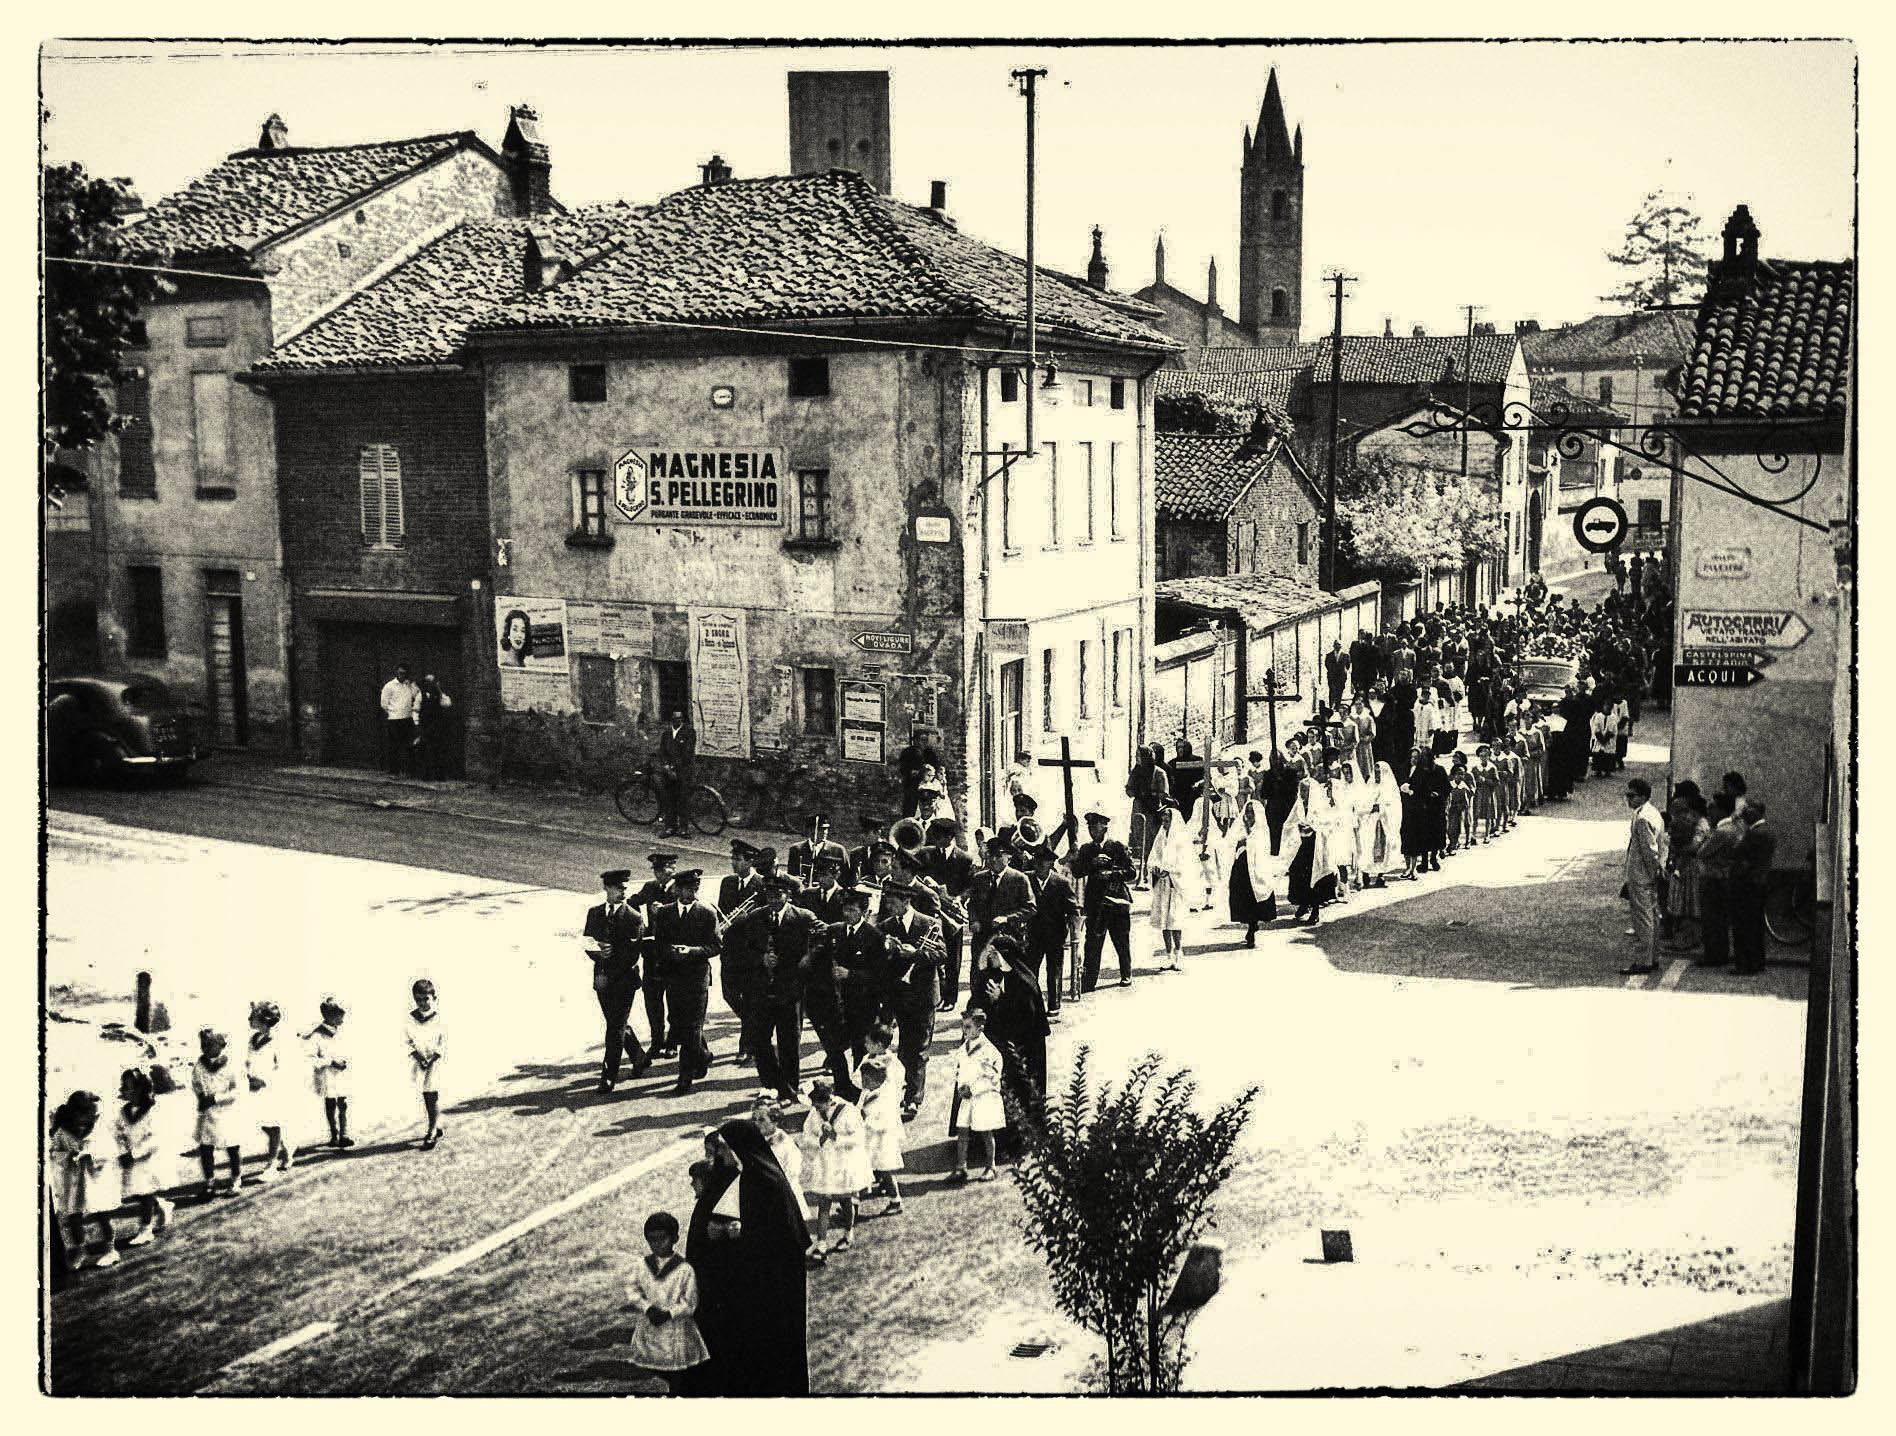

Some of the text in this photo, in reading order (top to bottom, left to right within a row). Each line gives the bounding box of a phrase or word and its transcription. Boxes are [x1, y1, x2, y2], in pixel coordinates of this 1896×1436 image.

[650, 452, 777, 479] MAGNESIA
[668, 481, 778, 507] PELLEGRINO
[1688, 613, 1791, 634] AUTOCARRI
[1700, 627, 1777, 637] VIETATO TRANSITO
[873, 640, 903, 649] OVADA
[1687, 669, 1735, 684] ACQUI
